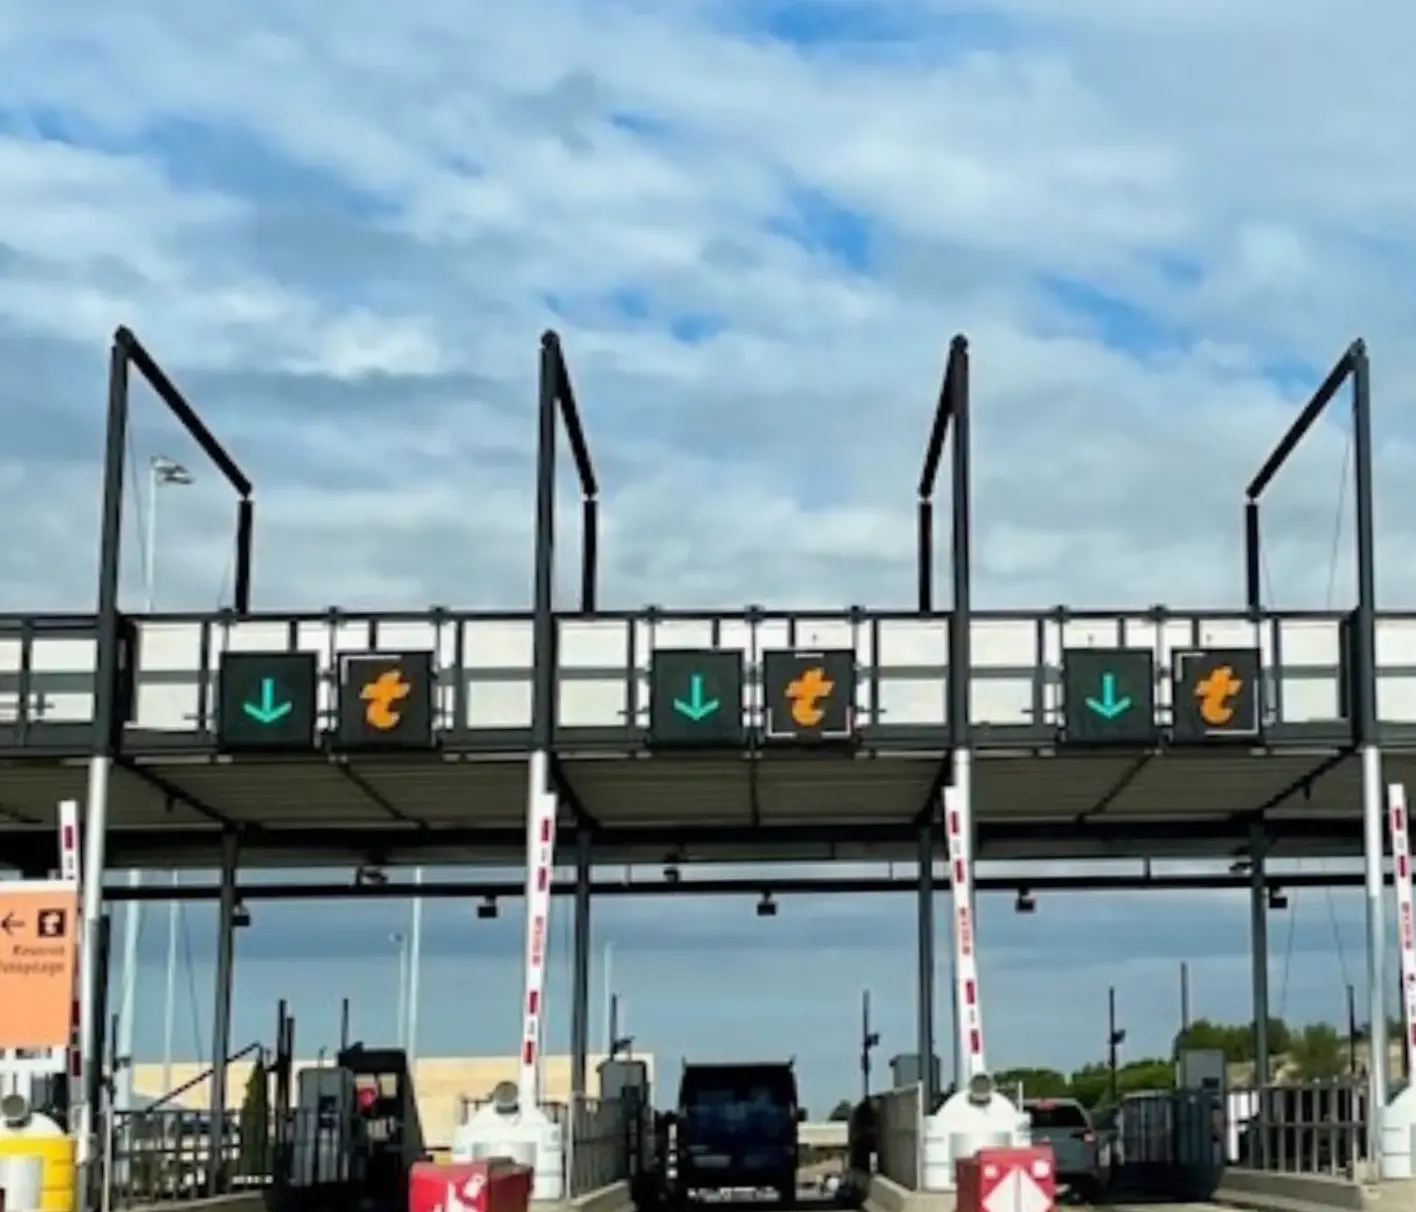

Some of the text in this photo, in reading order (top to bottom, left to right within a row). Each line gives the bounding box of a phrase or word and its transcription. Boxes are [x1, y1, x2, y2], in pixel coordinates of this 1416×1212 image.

[359, 668, 410, 728] t
[784, 668, 834, 727] t
[1195, 666, 1243, 724] t
